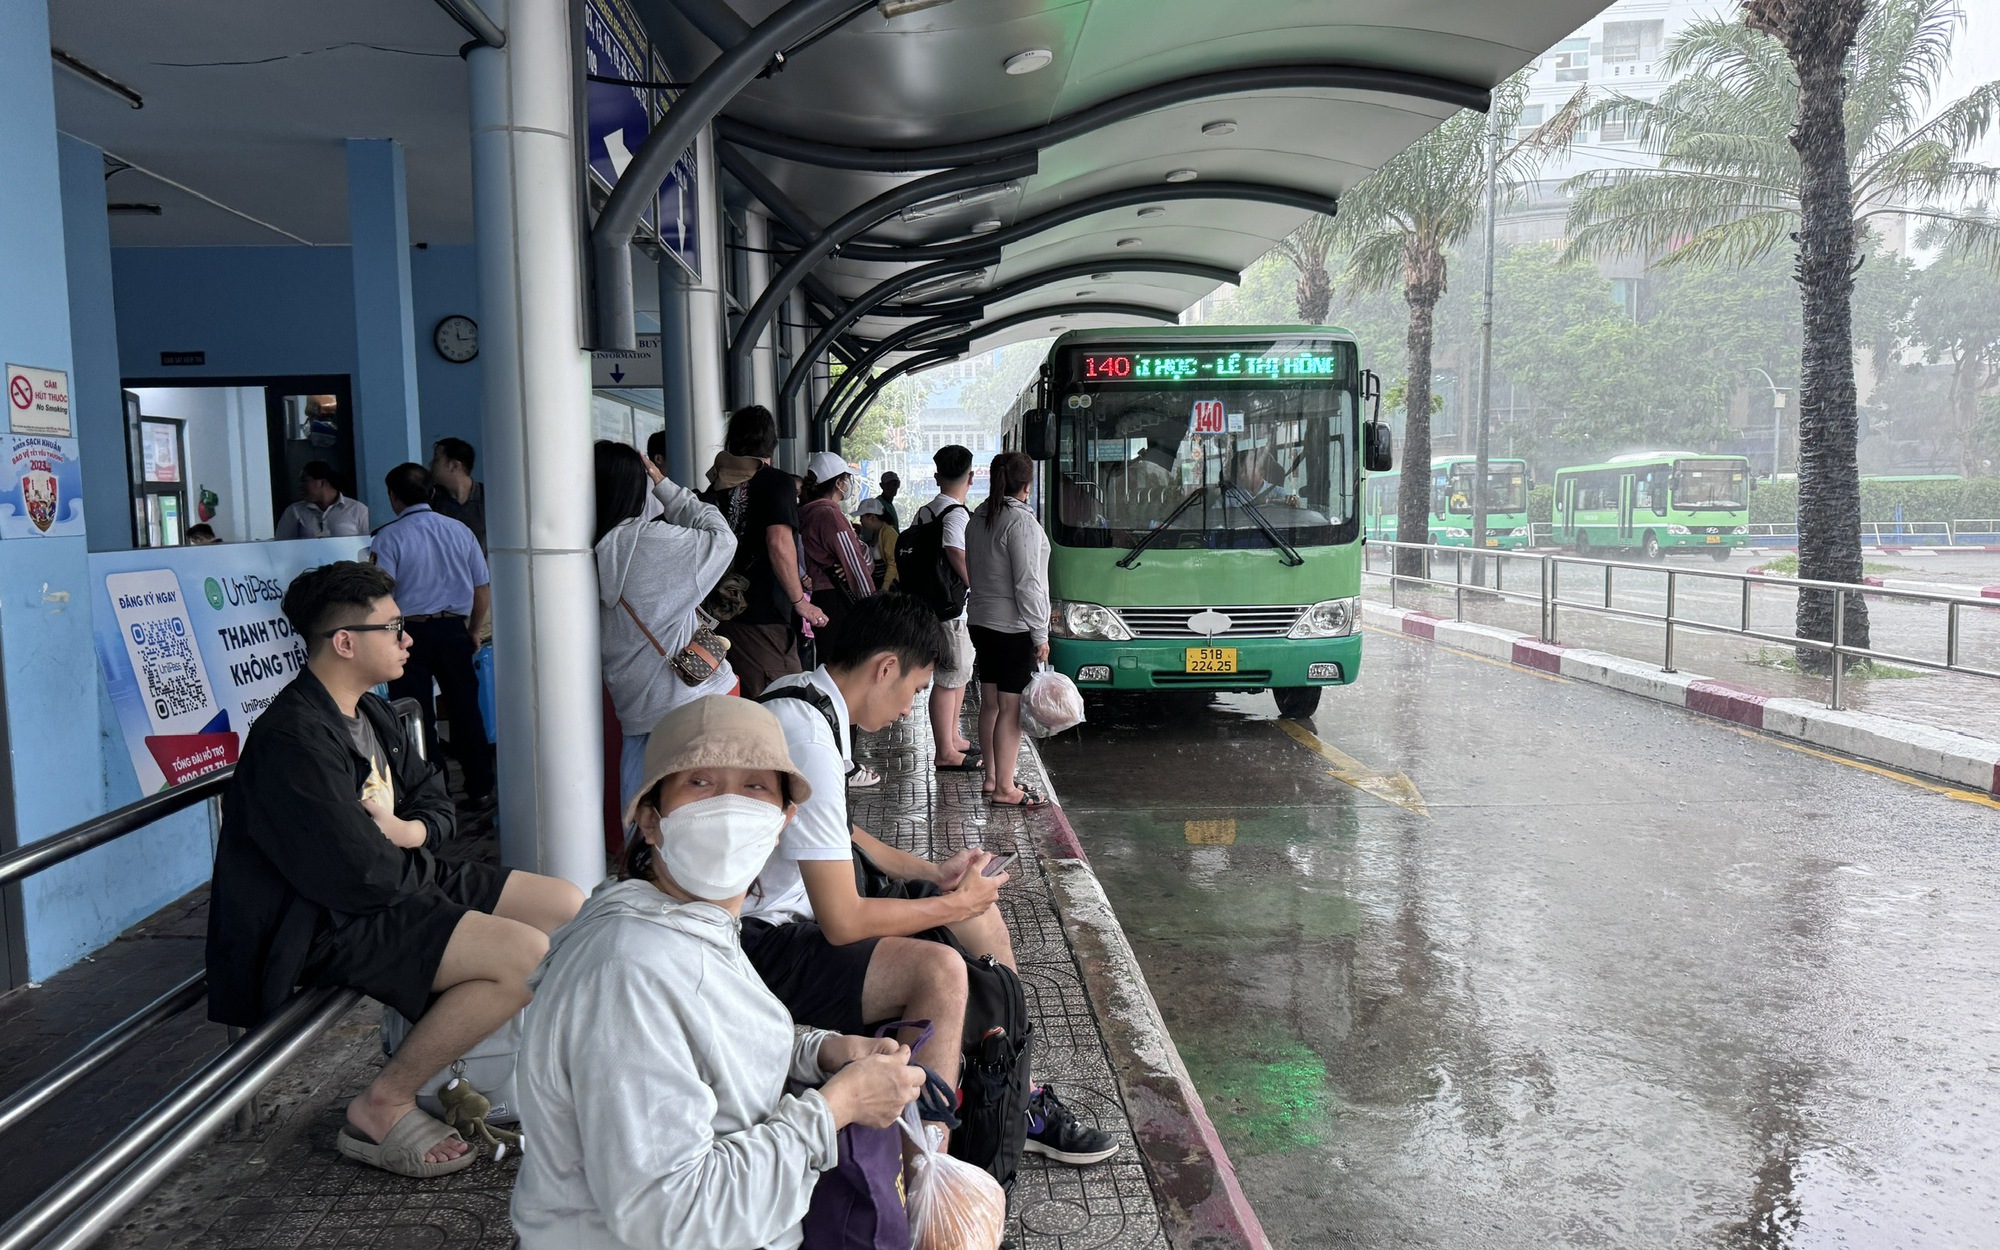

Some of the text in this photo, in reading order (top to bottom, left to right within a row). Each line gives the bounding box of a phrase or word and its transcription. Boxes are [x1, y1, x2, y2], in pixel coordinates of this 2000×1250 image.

[639, 339, 659, 348] BUY
[1086, 357, 1130, 377] 140
[36, 403, 68, 415] No Smoking
[1195, 402, 1223, 432] 140
[119, 590, 177, 609] ĐĂNG KÝ NGAY
[221, 574, 284, 607] UniPass
[218, 620, 270, 651] THANH
[1200, 649, 1223, 660] 51B
[158, 661, 183, 675] UniPass
[229, 653, 284, 687] KHÔNG
[1191, 660, 1232, 672] 224.25
[240, 698, 271, 714] UniPass
[172, 756, 192, 772] TỔNG
[191, 751, 203, 765] ĐÀI
[212, 744, 226, 758] TRỢ
